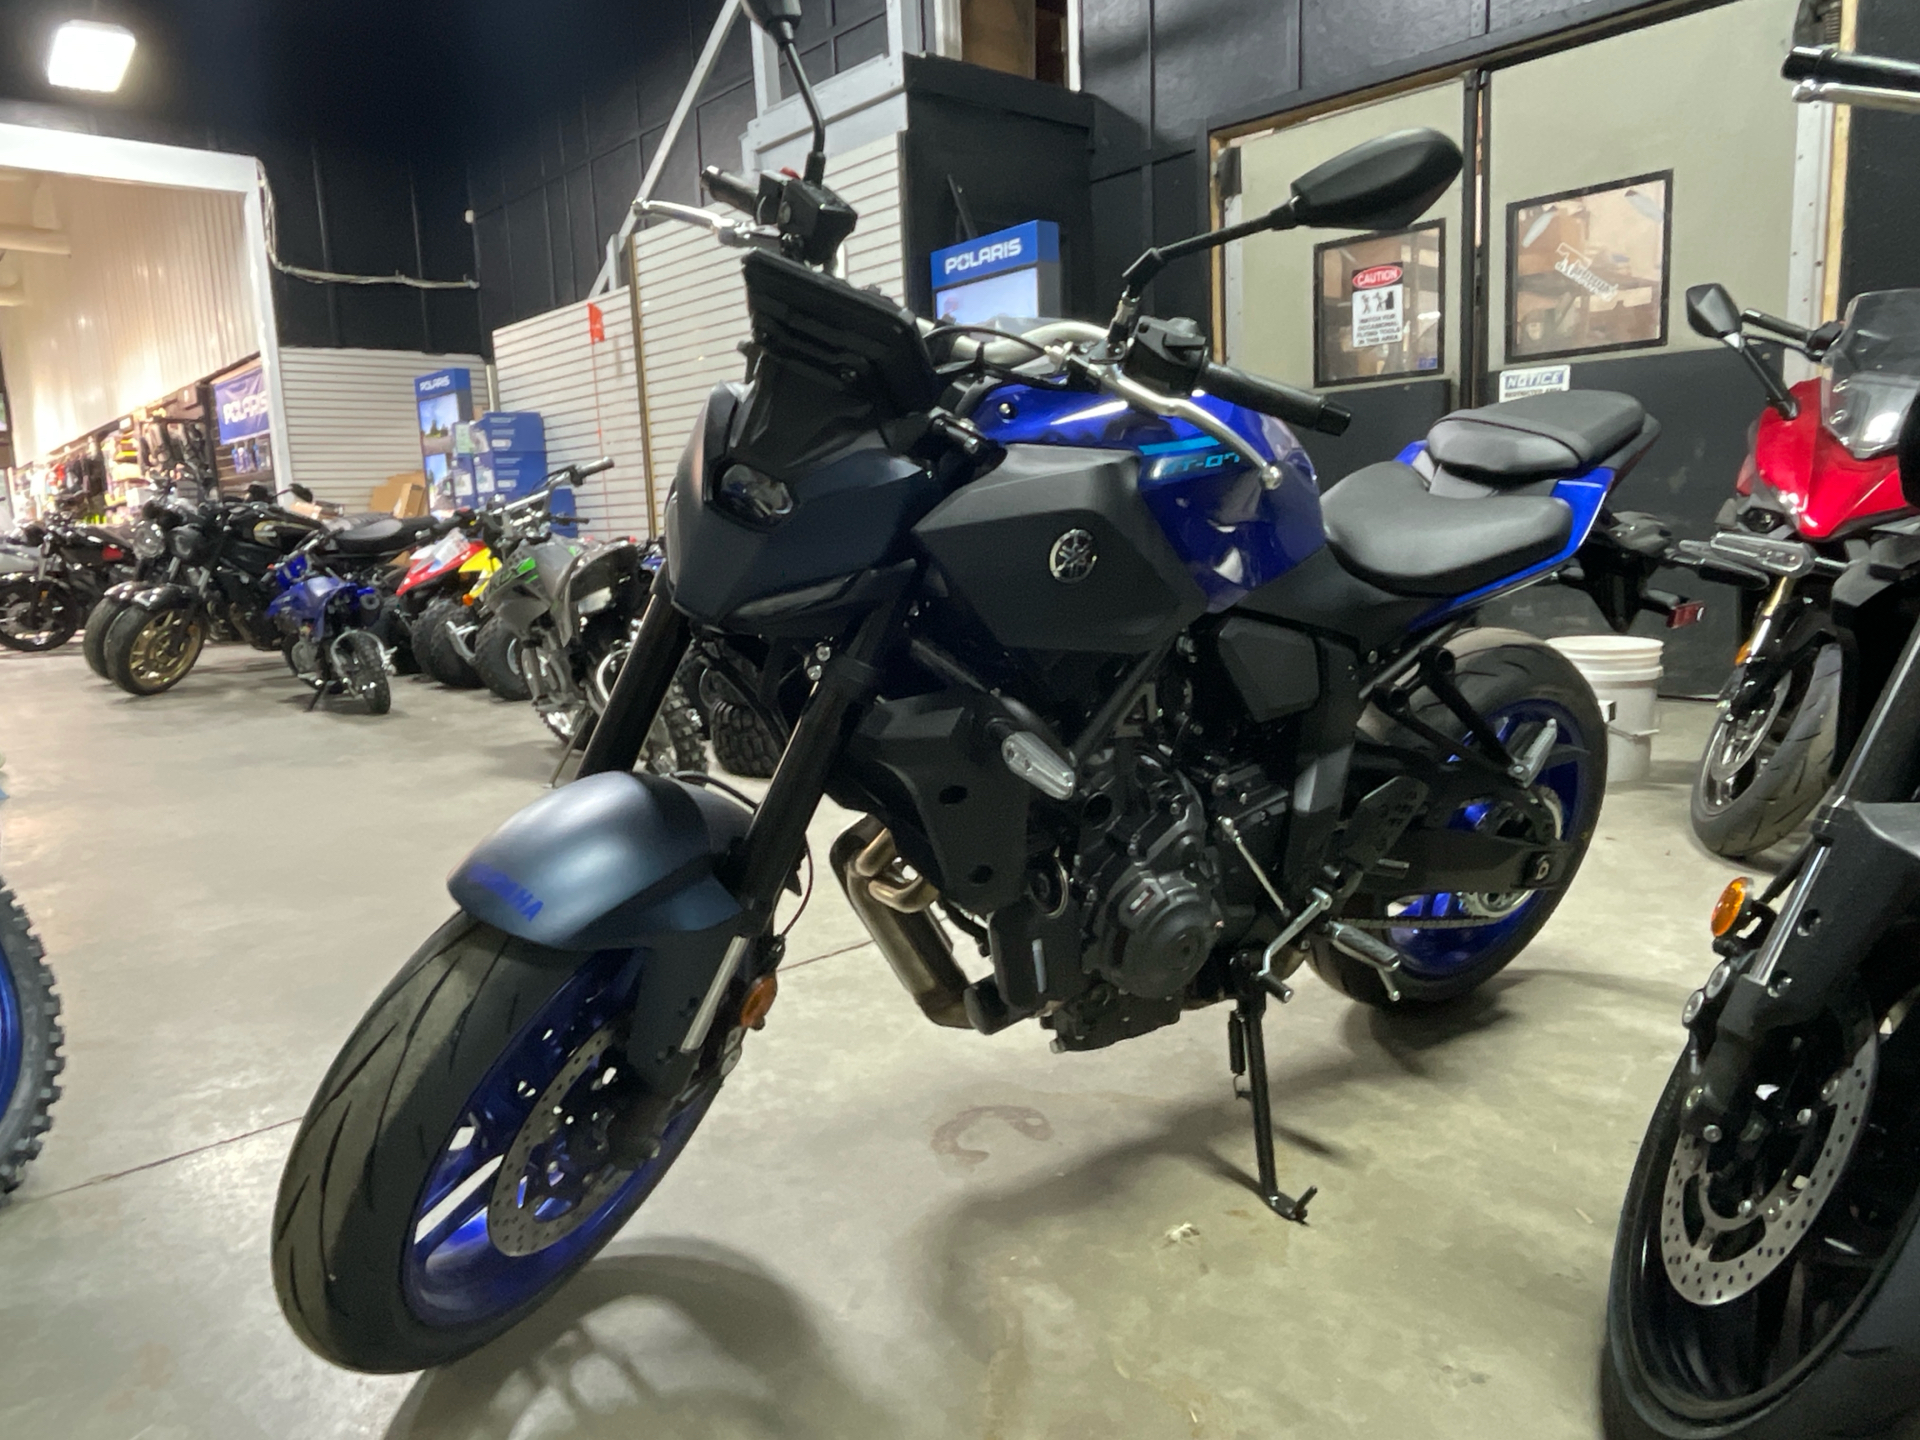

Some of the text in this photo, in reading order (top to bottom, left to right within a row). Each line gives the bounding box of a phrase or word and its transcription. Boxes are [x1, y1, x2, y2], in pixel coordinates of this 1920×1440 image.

[944, 237, 1022, 275] POLARIS
[1358, 270, 1398, 285] CAUTION
[419, 375, 450, 391] POLARIS
[1506, 371, 1563, 388] NOTICE
